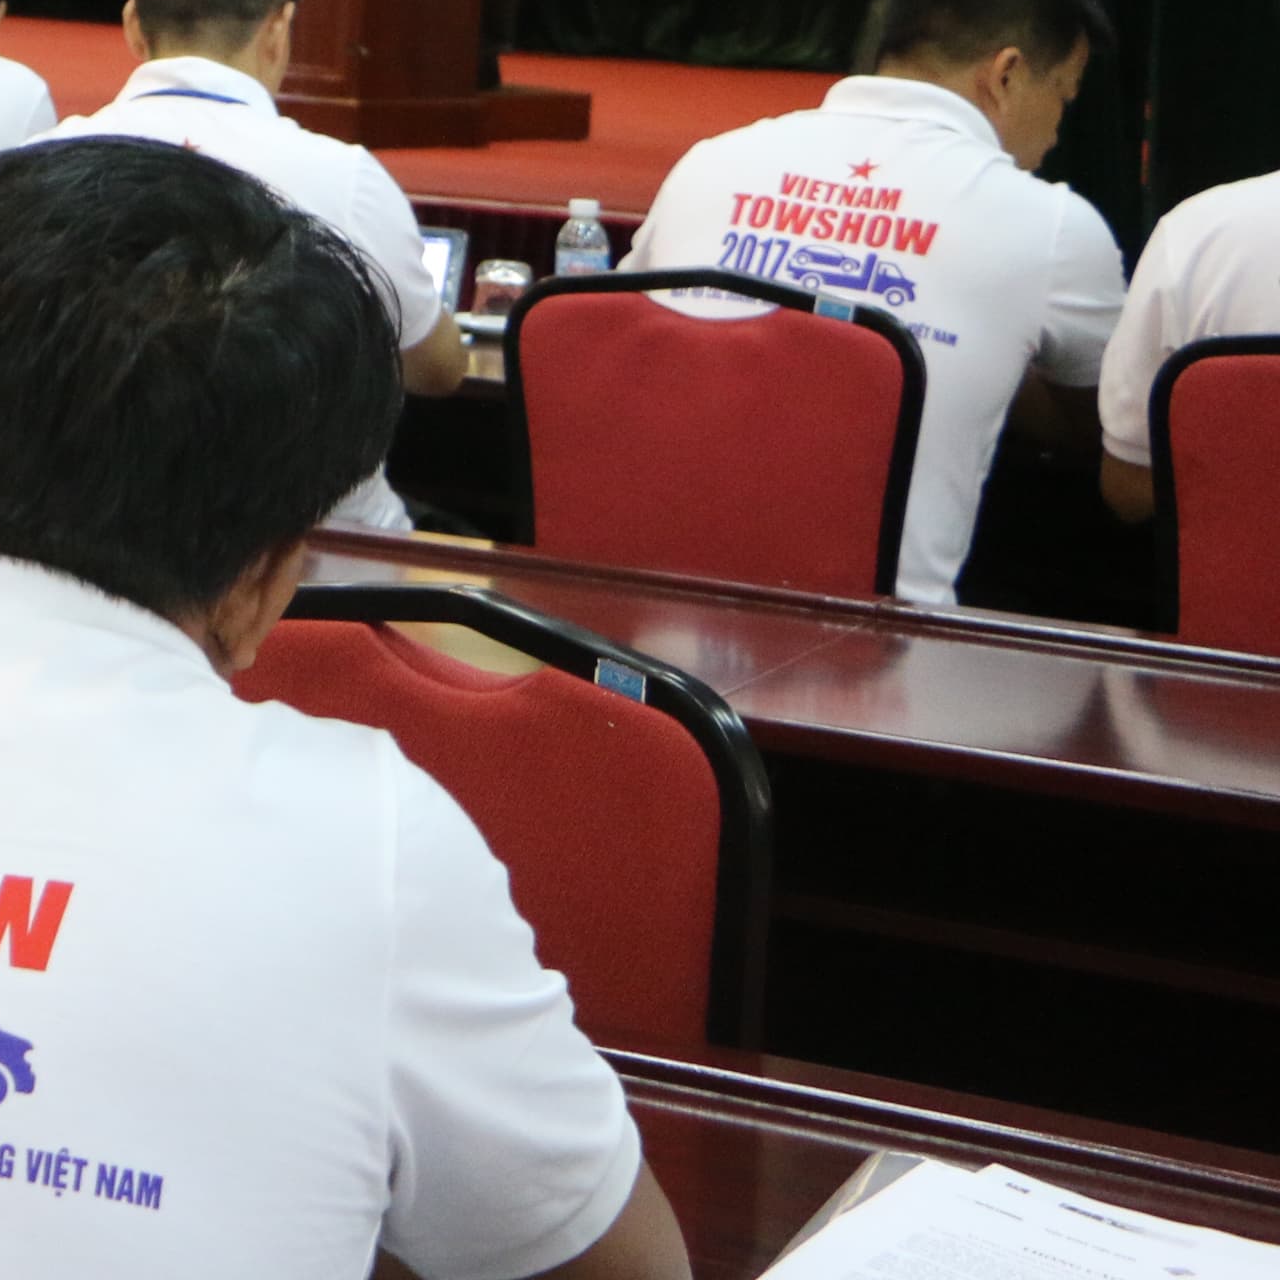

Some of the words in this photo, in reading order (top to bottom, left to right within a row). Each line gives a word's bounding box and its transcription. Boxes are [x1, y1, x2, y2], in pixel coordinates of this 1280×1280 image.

[780, 172, 902, 212] VIETNAM
[730, 193, 938, 256] TOWSHOW
[718, 231, 791, 281] 2017
[25, 1147, 89, 1197] VIỆT
[95, 1167, 165, 1210] NAM
